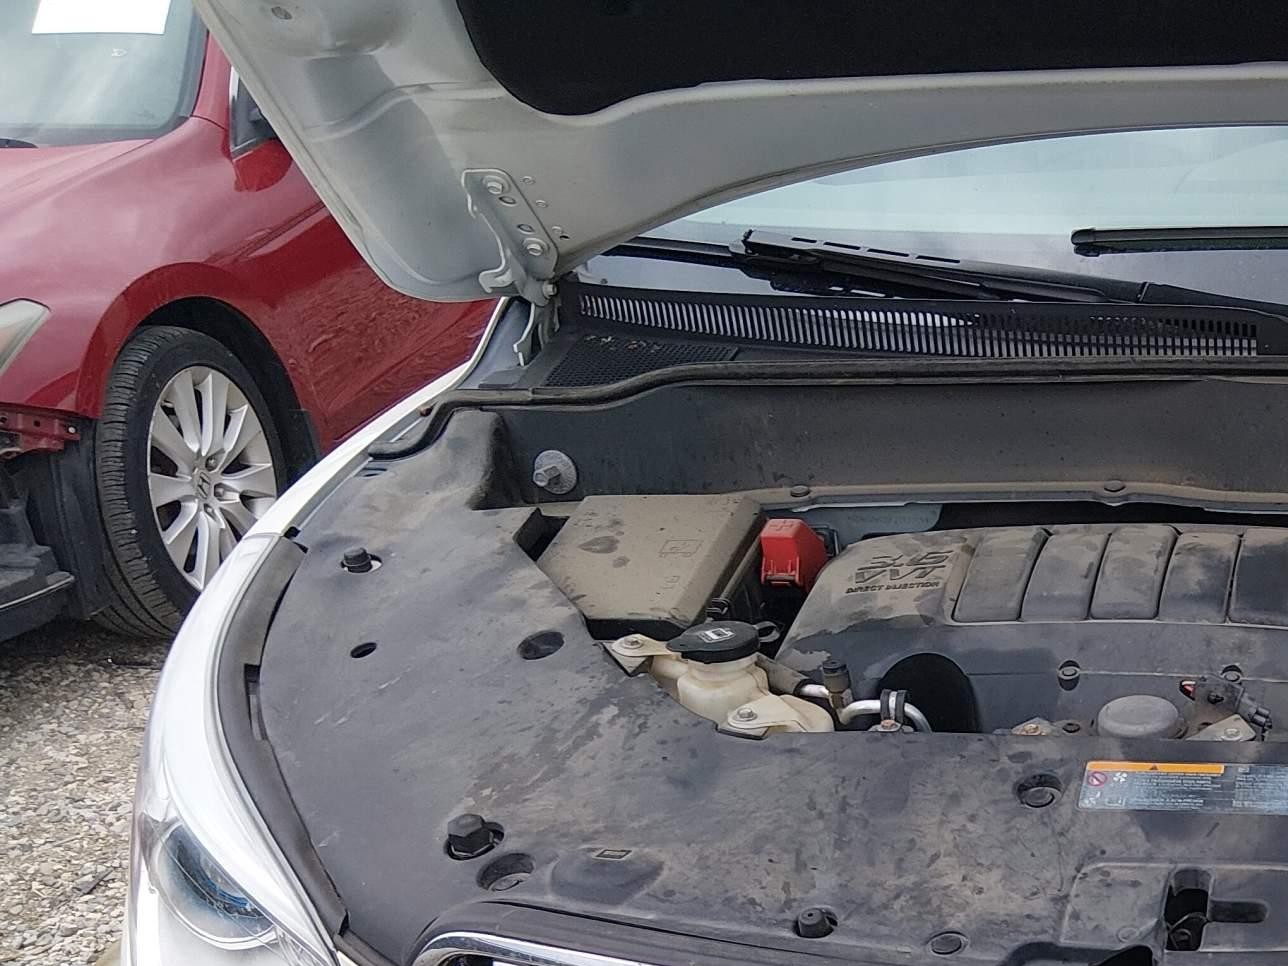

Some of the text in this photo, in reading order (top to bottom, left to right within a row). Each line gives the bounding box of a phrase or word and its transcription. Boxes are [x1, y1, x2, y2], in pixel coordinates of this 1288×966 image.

[855, 565, 946, 584] VVT
[845, 581, 940, 594] DIRECT INJECTION
